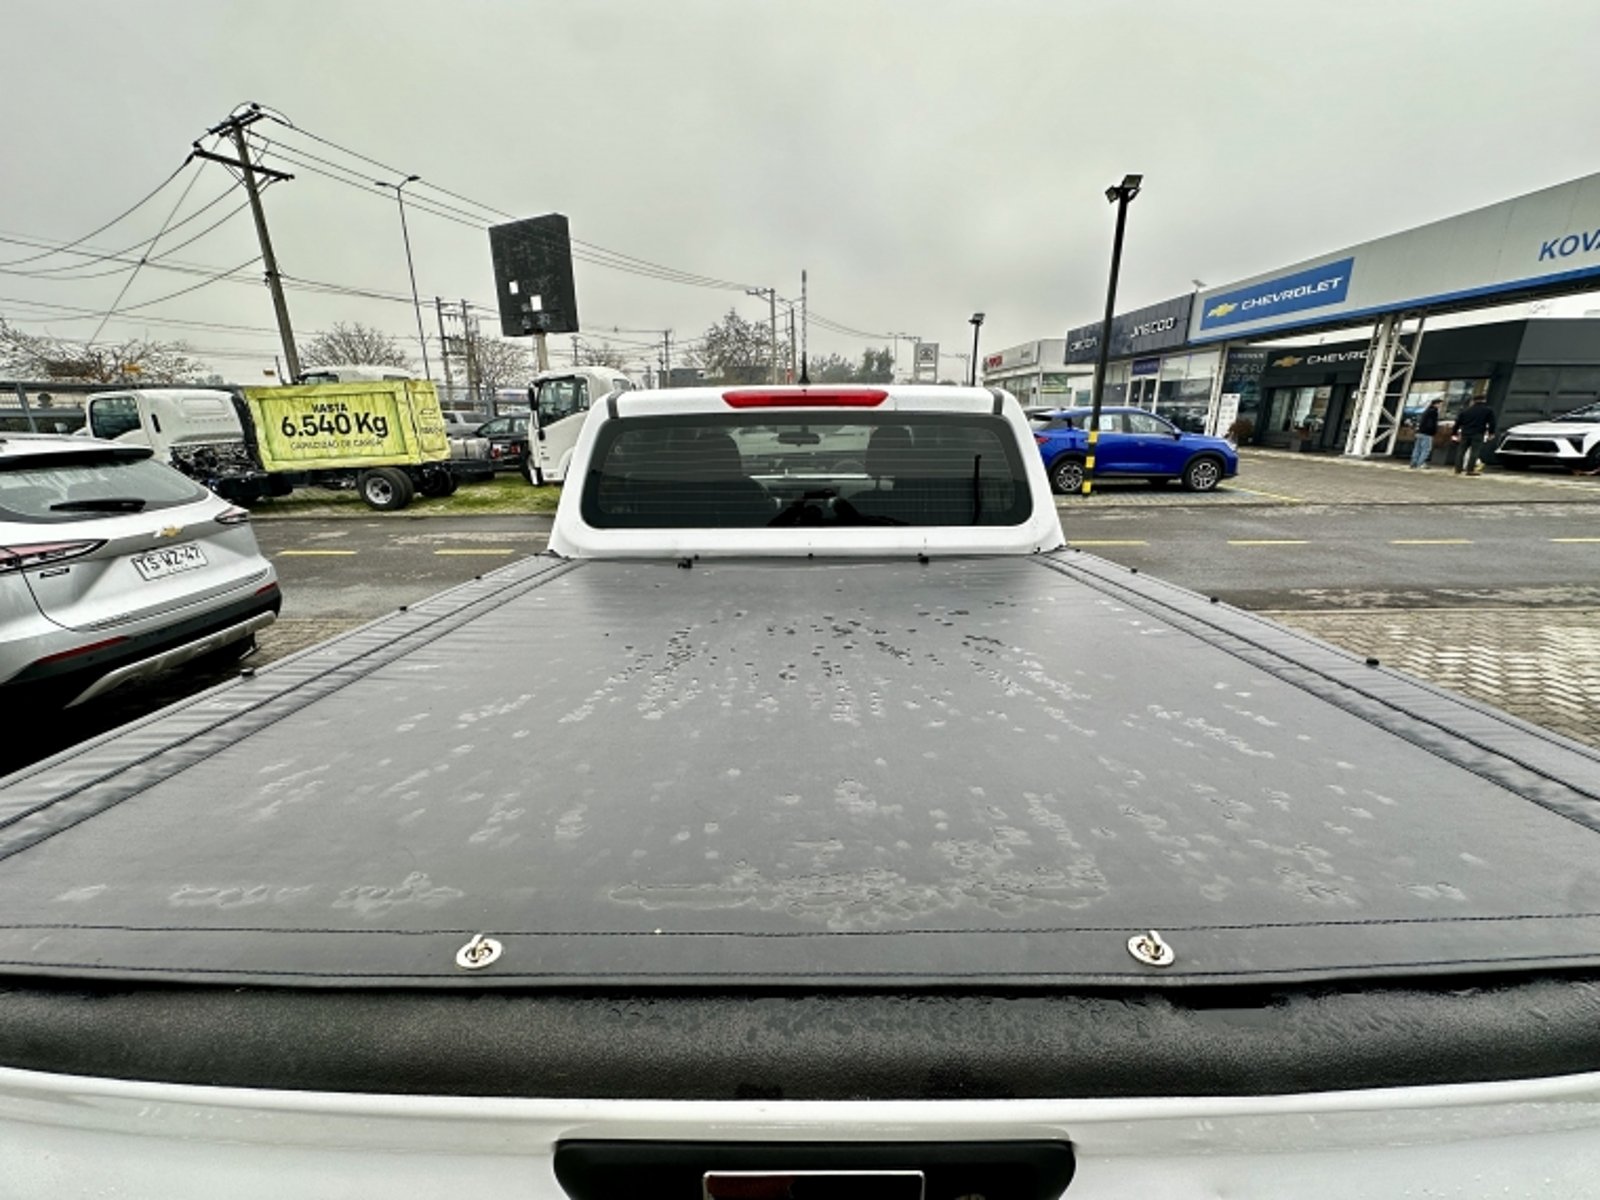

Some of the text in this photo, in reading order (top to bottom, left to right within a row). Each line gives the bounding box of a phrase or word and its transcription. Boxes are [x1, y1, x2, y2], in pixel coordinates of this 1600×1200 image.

[1241, 277, 1343, 310] CHEVROLET
[1306, 350, 1369, 365] CHEVRO
[312, 403, 348, 413] HASTA
[282, 412, 389, 438] 6.540 Kg
